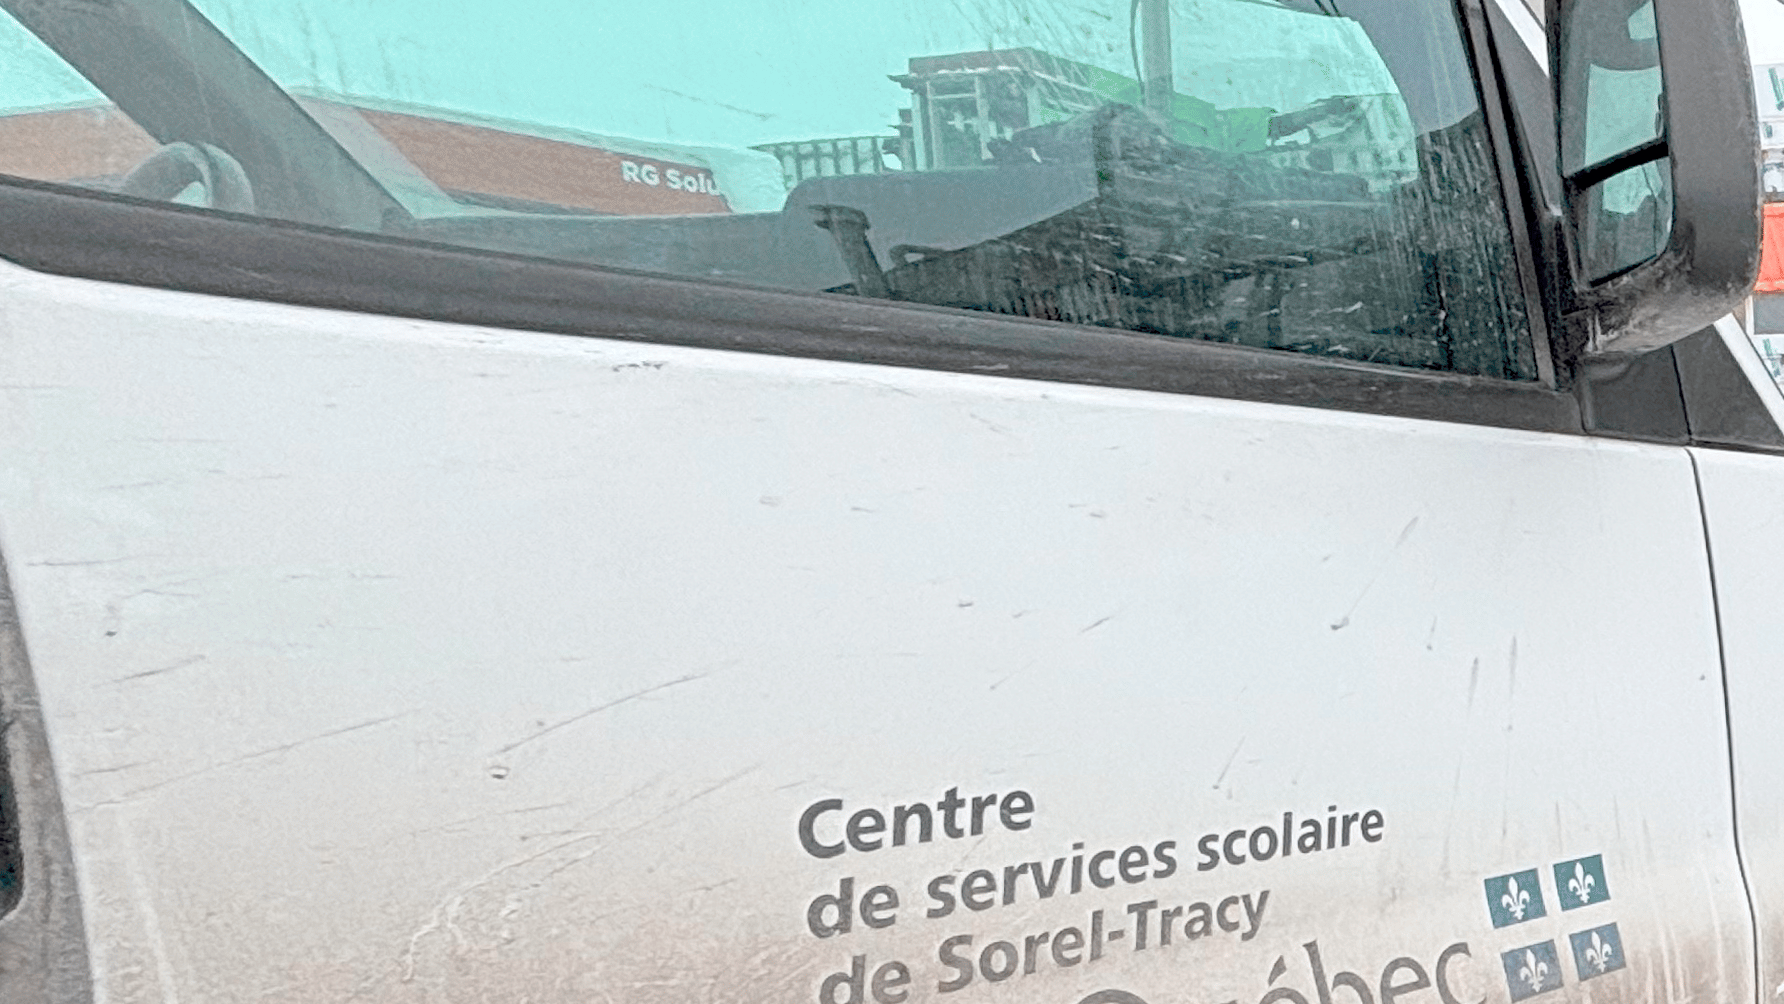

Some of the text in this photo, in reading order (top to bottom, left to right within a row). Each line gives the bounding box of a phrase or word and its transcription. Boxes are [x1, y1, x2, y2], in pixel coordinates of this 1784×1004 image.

[621, 160, 660, 186] RG
[798, 787, 1035, 858] Centre
[807, 805, 1385, 938] de services scolaire
[937, 886, 1269, 993] Sorel-Tracy
